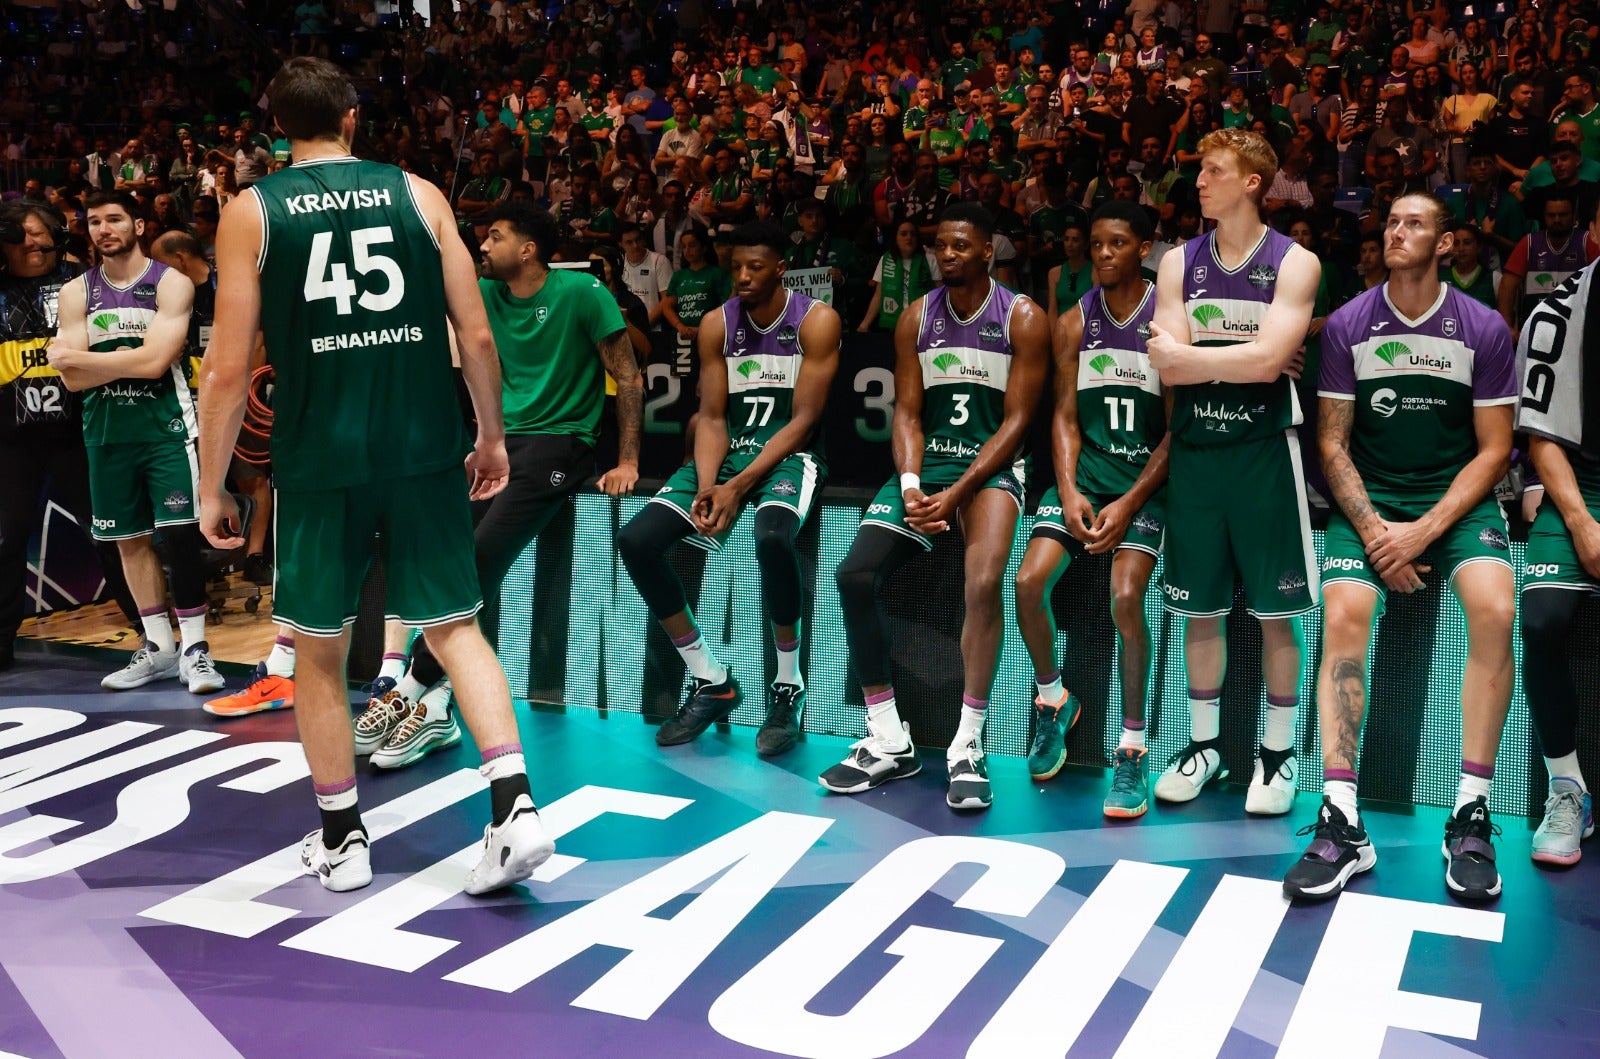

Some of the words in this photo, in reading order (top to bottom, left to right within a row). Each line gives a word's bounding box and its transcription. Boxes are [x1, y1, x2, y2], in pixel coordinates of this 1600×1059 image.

[285, 188, 392, 215] KRAVISH
[304, 226, 405, 315] 45
[781, 275, 806, 288] HOSE
[809, 273, 831, 285] WHO
[118, 321, 148, 331] Unicaja
[1222, 319, 1259, 333] Unicaja
[311, 324, 423, 354] BENAHAVÍS
[21, 348, 49, 367] HB
[1409, 354, 1452, 370] Unicaja
[960, 365, 989, 379] Unicaja
[25, 385, 62, 412] 02
[644, 362, 682, 434] 2
[853, 367, 897, 443] 3
[1401, 402, 1430, 410] MÁLAGA
[1434, 398, 1448, 406] SOL
[743, 396, 775, 427] 77
[949, 393, 971, 426] 3
[1104, 396, 1135, 432] 11
[1193, 401, 1253, 423] ndalucía
[926, 437, 981, 456] Andalucí
[1494, 484, 1513, 495] caja
[1036, 505, 1063, 517] aga
[1322, 556, 1364, 571] álaga
[1525, 562, 1559, 577] laga
[1164, 583, 1190, 601] aga
[136, 767, 1506, 1059] LEAGUE
